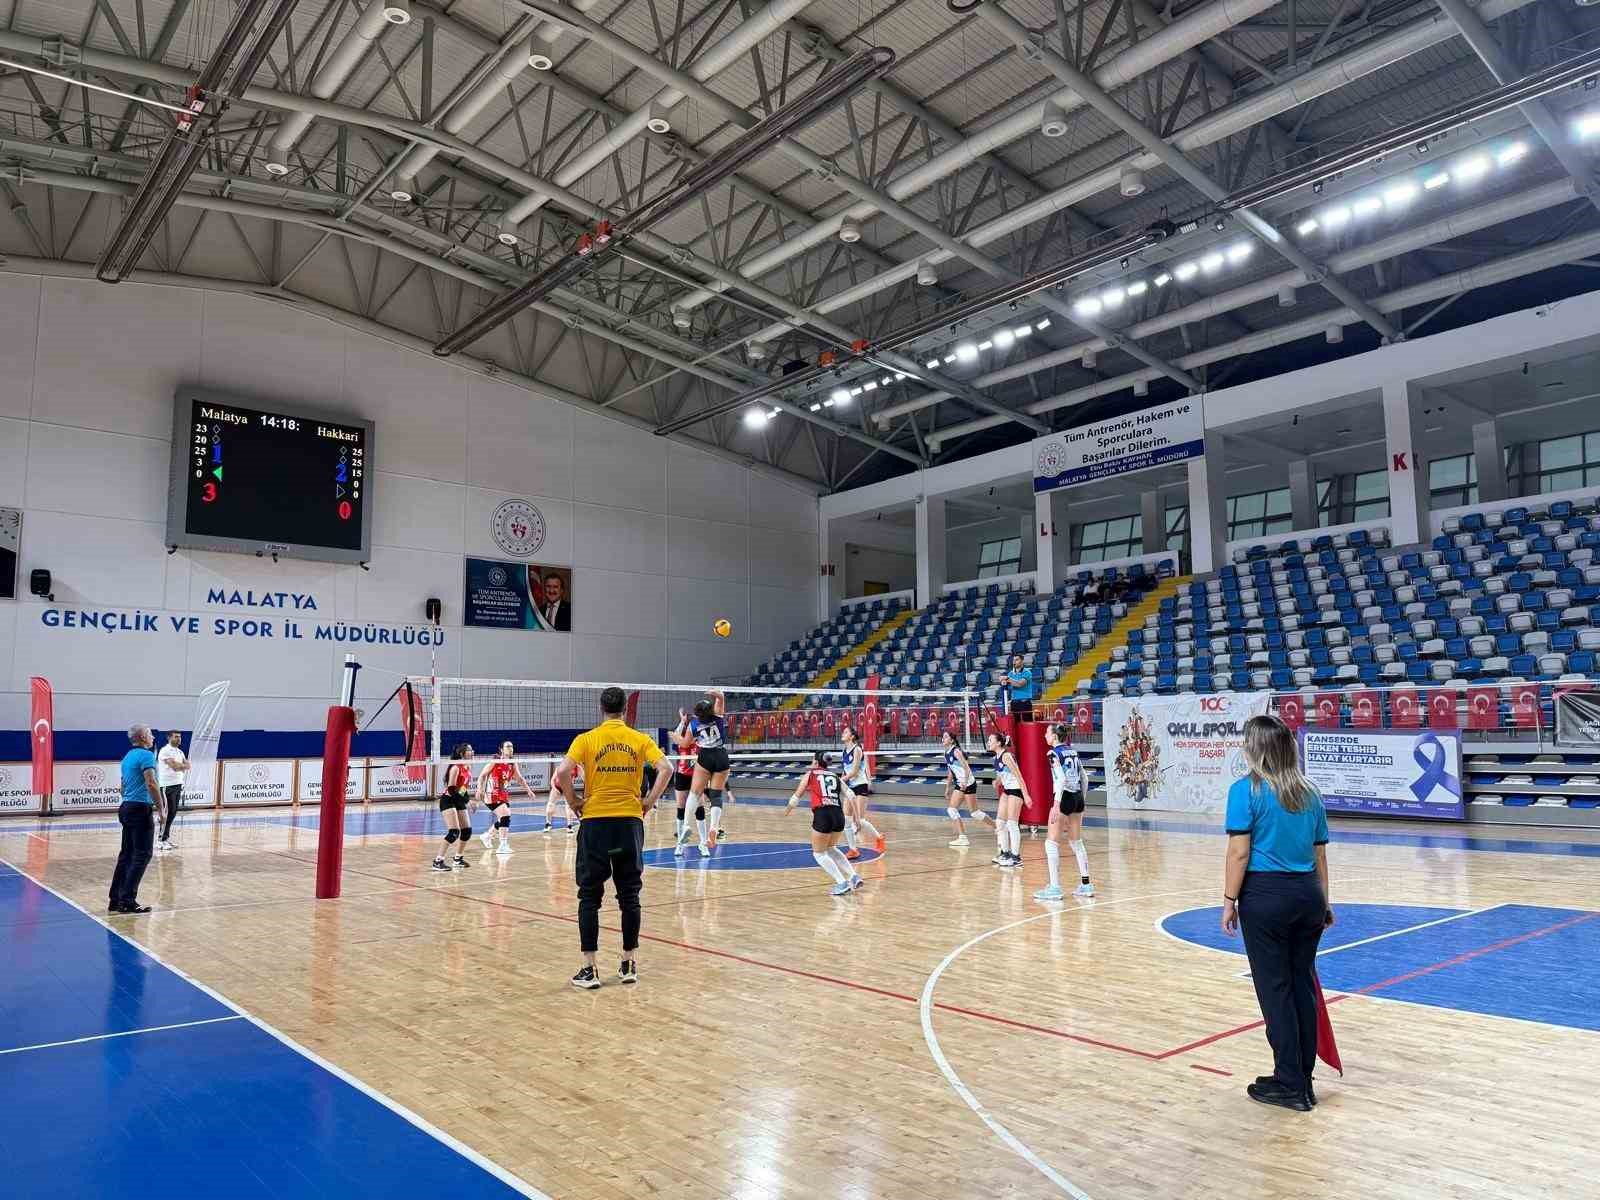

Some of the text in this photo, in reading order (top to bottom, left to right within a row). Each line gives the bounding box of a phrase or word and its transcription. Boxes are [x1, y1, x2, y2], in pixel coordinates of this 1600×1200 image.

[201, 408, 248, 424] Malatya
[260, 415, 300, 431] 14:18:
[196, 423, 208, 433] 23
[1064, 404, 1191, 444] Tüm Antrenör, Hakem ve
[195, 435, 208, 445] 20
[317, 426, 359, 442] Hakkari
[1097, 426, 1153, 448] Sporculara
[194, 446, 207, 456] 25
[352, 448, 363, 457] 25
[1082, 438, 1171, 464] Başarılar Dilerim.
[352, 459, 363, 468] 25
[1393, 452, 1408, 471] K
[352, 469, 362, 478] 15
[202, 482, 217, 502] 3
[1041, 522, 1048, 536] L
[207, 588, 317, 611] MALATYA
[41, 609, 444, 647] GENÇLİK VE SPOR İL MÜDÜRLÜĞÜ
[1168, 722, 1200, 737] OKUL
[1307, 736, 1359, 744] KANSERDE
[1308, 744, 1339, 752] ERKEN
[1308, 753, 1393, 765] HAYAT KURTARIR
[60, 787, 93, 796] GENÇLİK
[817, 775, 838, 797] 12
